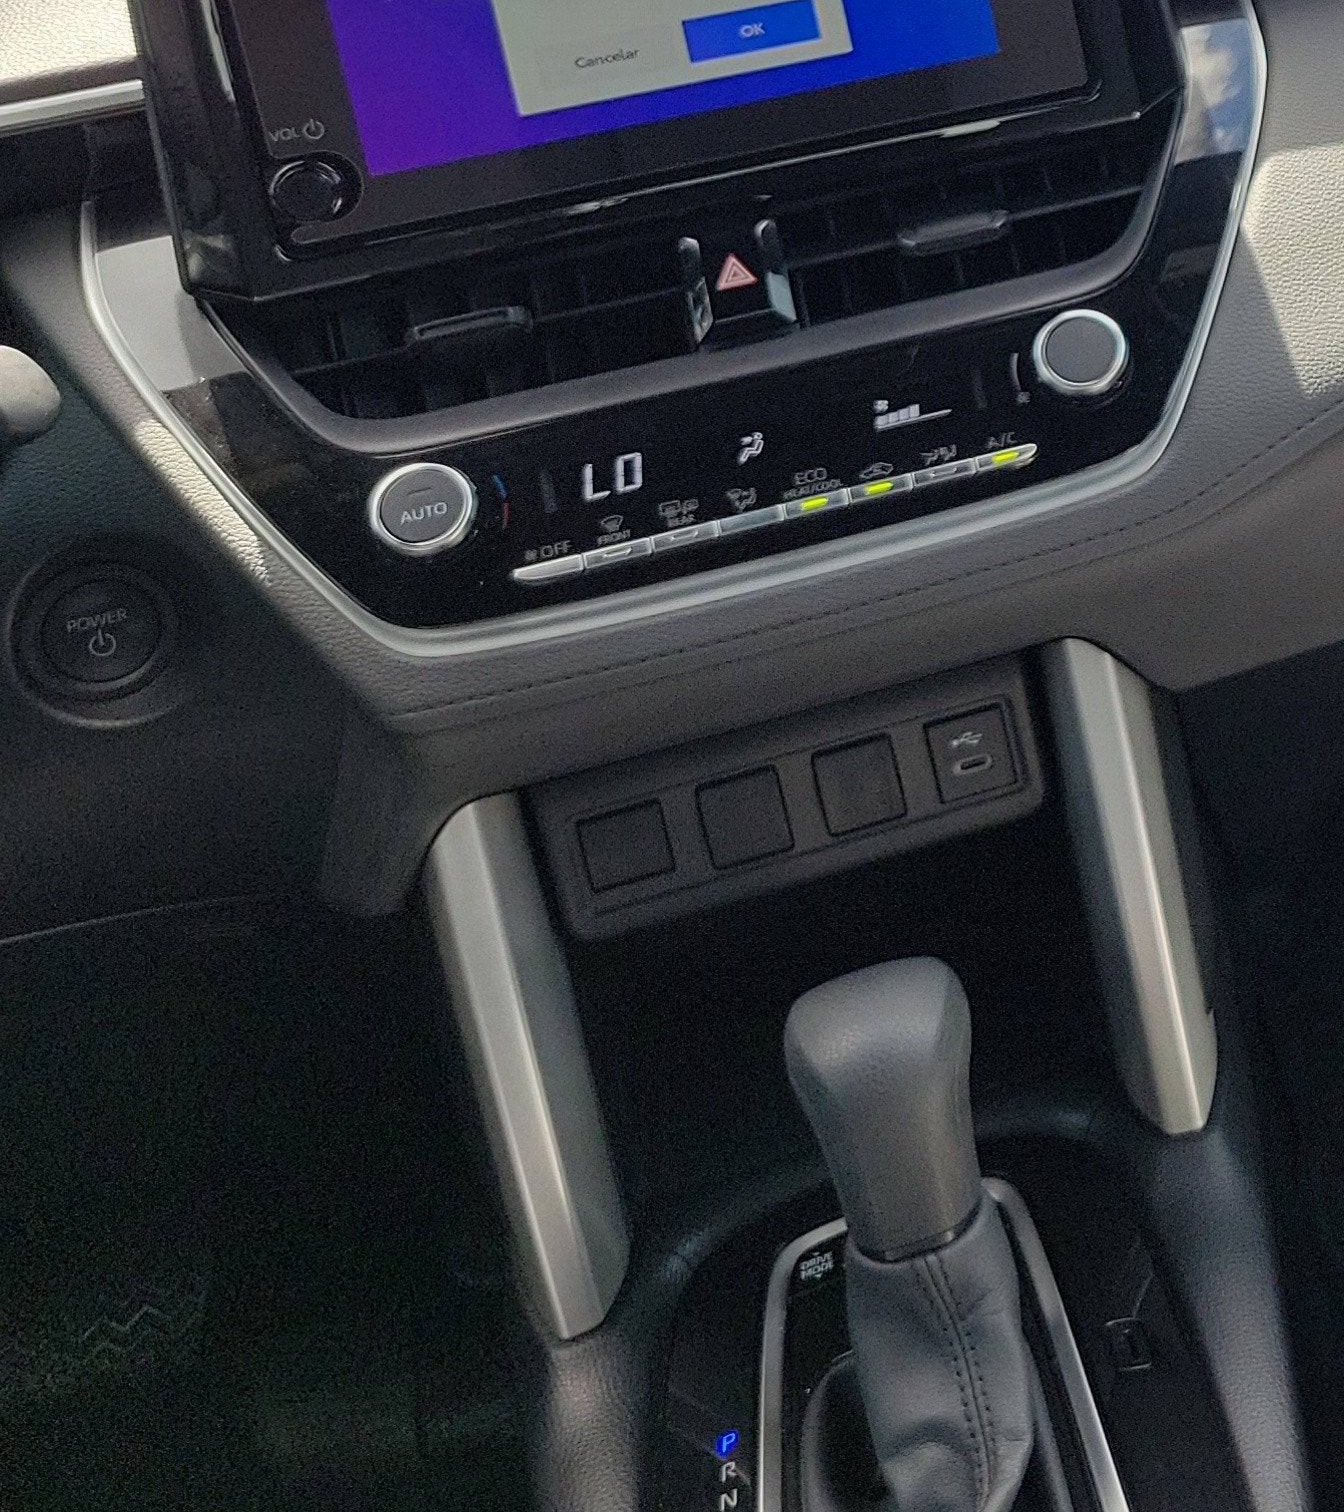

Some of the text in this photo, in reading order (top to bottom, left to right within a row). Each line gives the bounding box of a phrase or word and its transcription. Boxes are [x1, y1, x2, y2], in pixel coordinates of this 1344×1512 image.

[739, 22, 766, 38] OK
[574, 48, 640, 69] Cancelar
[269, 126, 300, 141] VOL
[986, 431, 1018, 449] A/C
[794, 466, 828, 486] ECO
[399, 501, 448, 525] AUTO
[540, 540, 572, 559] OFF
[66, 608, 128, 633] POWER
[800, 1251, 833, 1270] DRIVE
[800, 1261, 834, 1280] MODE
[721, 1432, 736, 1454] P
[720, 1461, 738, 1483] R
[719, 1488, 738, 1512] N
